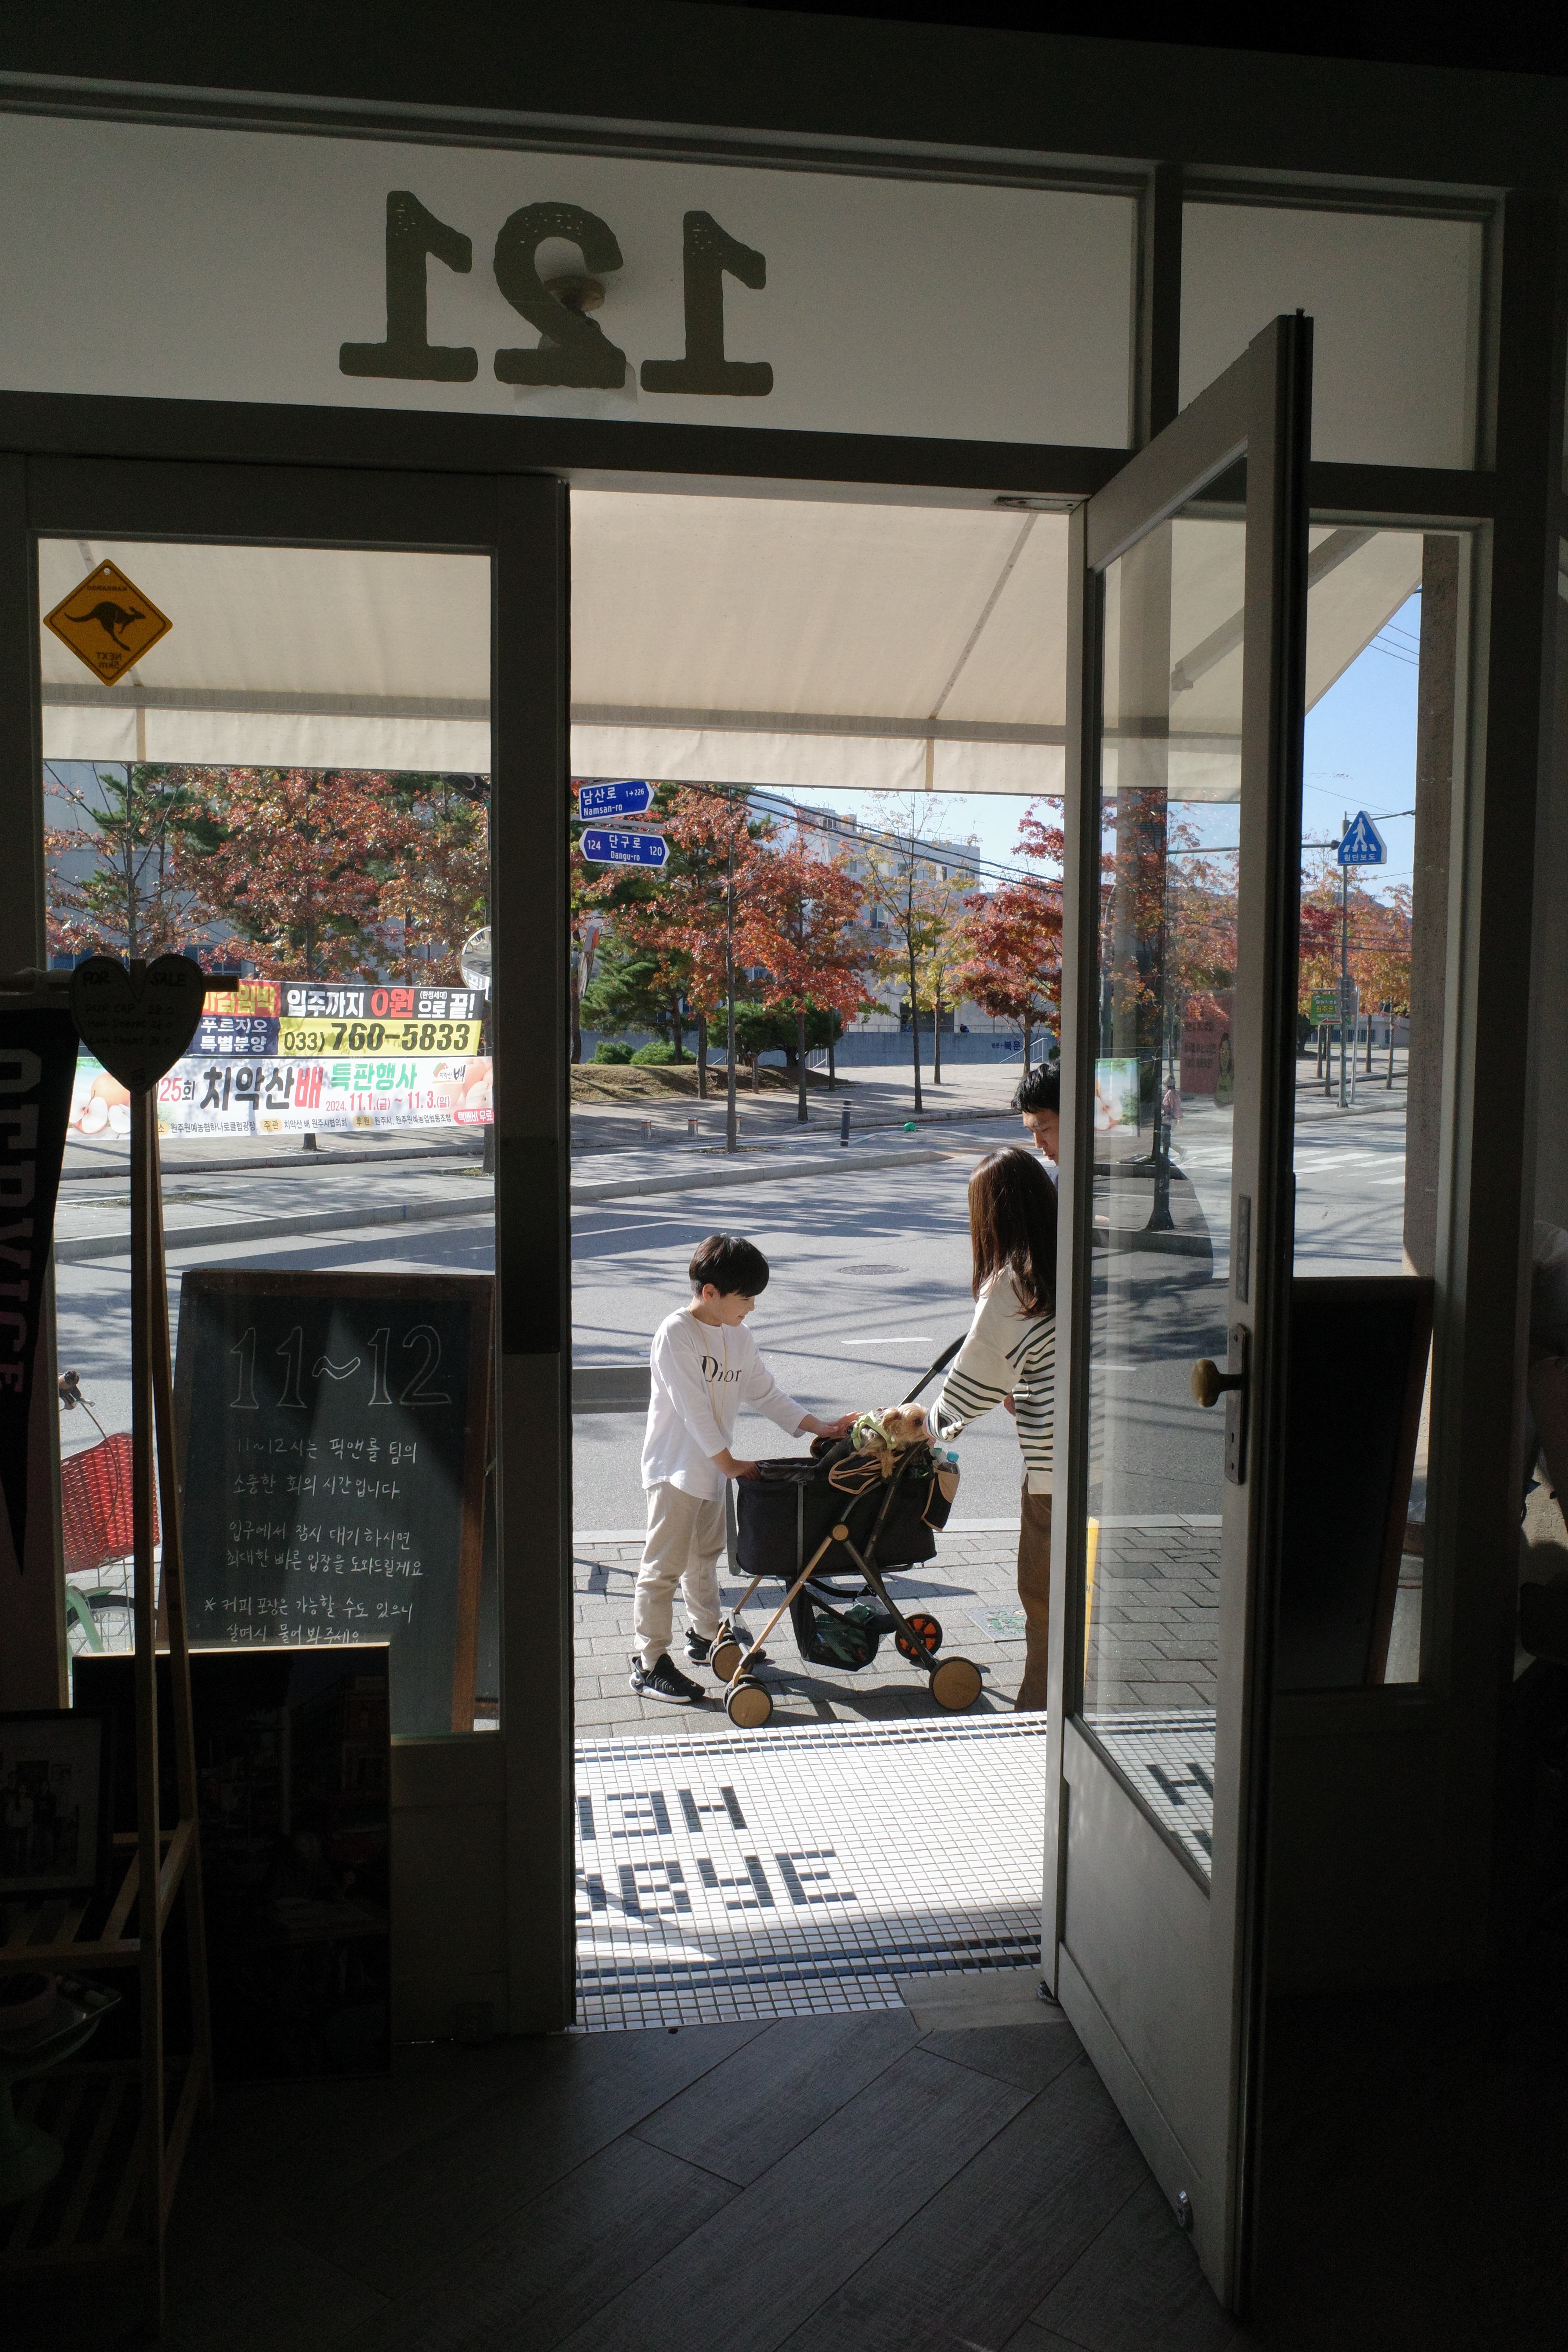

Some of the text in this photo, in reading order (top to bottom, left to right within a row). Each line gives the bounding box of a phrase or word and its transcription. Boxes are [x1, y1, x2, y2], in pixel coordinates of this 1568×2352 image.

[583, 787, 617, 805] 남산로
[584, 804, 622, 816] Namsan-ro
[588, 835, 662, 856] 124 단구로 120
[611, 851, 640, 861] Dangu-ro
[1344, 853, 1376, 862] 횡단보도
[83, 971, 187, 987] FOR SALE
[203, 985, 276, 1014] 감임박
[287, 988, 476, 1019] 입주까지 0원 (한정세대) 으로 끝!
[201, 1017, 267, 1034] 푸르지오
[200, 1035, 267, 1052] 특별분양
[157, 1077, 196, 1102] 25회
[331, 1062, 417, 1091] 특판행사
[326, 1100, 347, 1111] 2024.
[284, 1120, 302, 1129] 치악산
[304, 1120, 310, 1129] 배
[312, 1118, 347, 1129] 원주시협의회
[457, 1111, 479, 1123] 택배비
[479, 1110, 493, 1121] 무료
[230, 1325, 452, 1409] 11~12
[700, 1355, 742, 1383] Dior
[238, 1437, 417, 1465] 11~12시는 픽앤롤 팀의
[233, 1474, 276, 1494] 소중한
[287, 1474, 317, 1496] 회의
[229, 1520, 286, 1542] 입구에서
[296, 1525, 322, 1543] 잠시
[227, 1548, 269, 1568] 최대한
[274, 1547, 302, 1571] 빠른
[308, 1551, 345, 1574] 입장을
[222, 1594, 413, 1625] 커피 포장은 가능할 수도 있으니
[227, 1623, 267, 1643] 살며시
